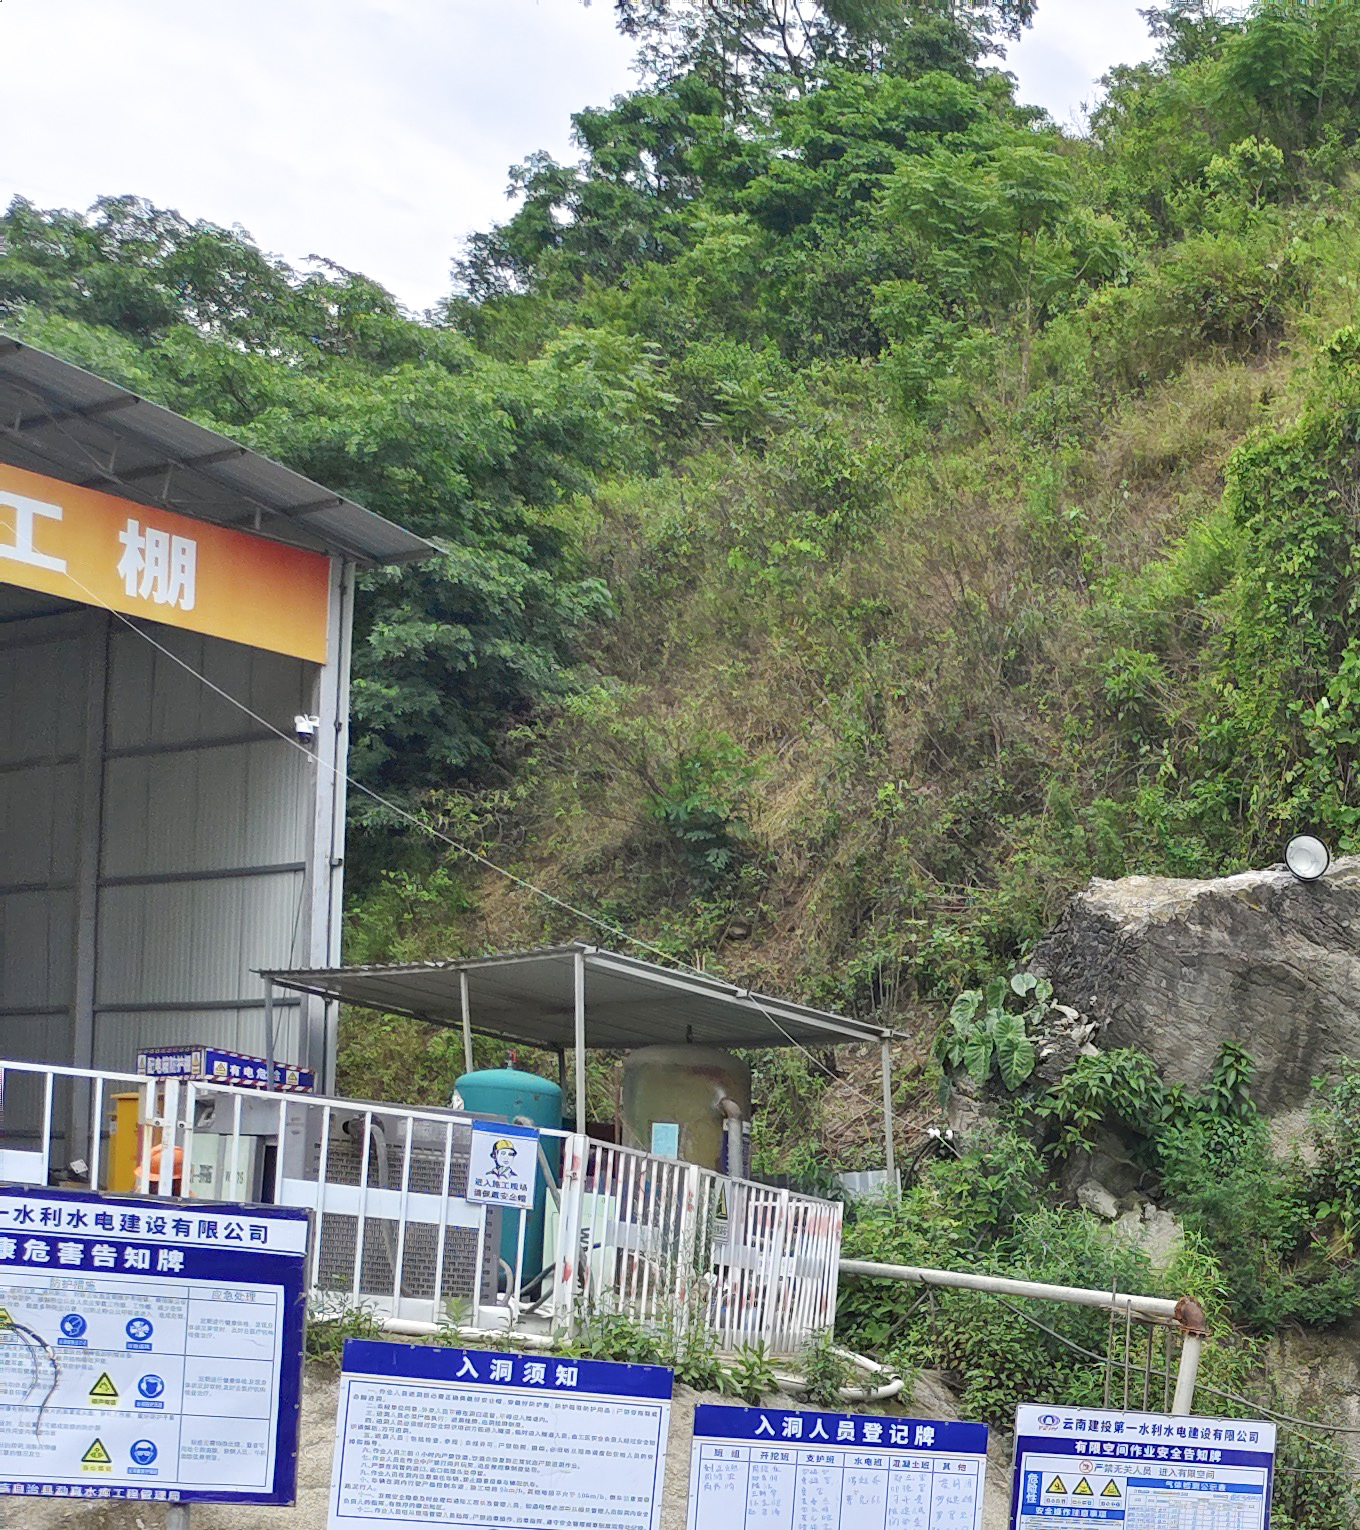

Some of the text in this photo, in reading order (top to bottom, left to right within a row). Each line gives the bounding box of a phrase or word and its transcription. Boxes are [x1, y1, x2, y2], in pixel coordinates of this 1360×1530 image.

[0, 490, 197, 611] 工棚
[475, 1178, 528, 1192] 进入施工现场
[455, 1356, 578, 1387] 入洞须知
[755, 1414, 936, 1447] 入洞人员登记牌
[1062, 1417, 1260, 1444] 云南建投第一水利水电建设有限公司
[854, 1457, 883, 1467] 水电班
[1075, 1440, 1222, 1463] 有限空间作业安全告知牌
[1093, 1462, 1215, 1480] 严禁无关人员 进入有限空间
